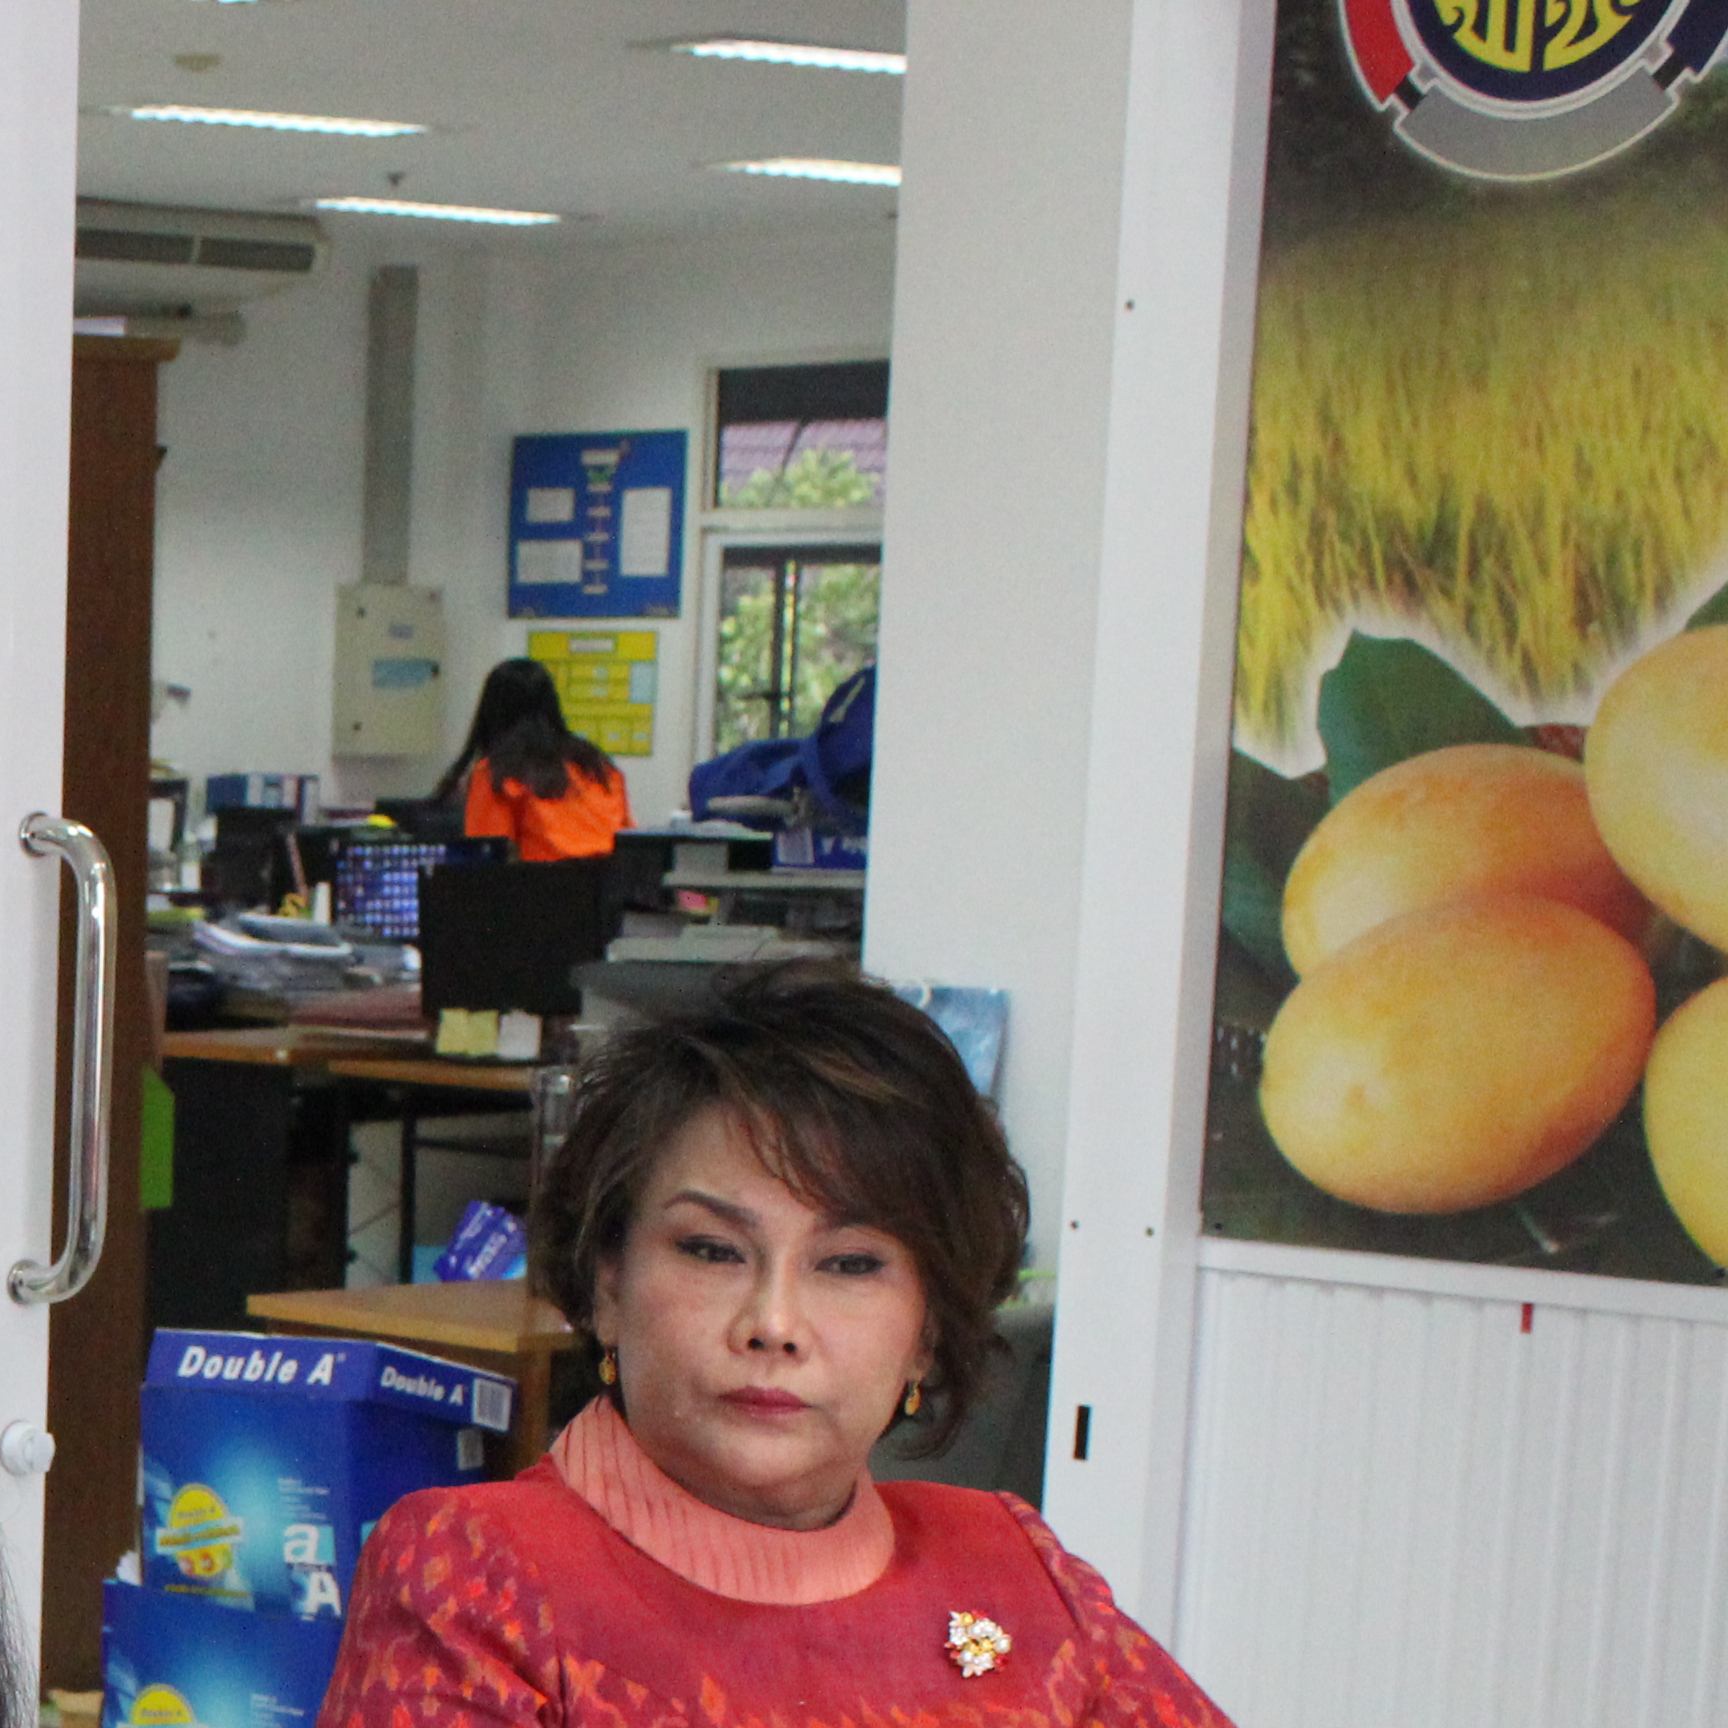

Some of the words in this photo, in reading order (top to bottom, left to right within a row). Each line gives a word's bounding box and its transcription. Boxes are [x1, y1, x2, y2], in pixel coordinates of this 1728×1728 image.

[177, 1345, 301, 1384] Double
[307, 1351, 338, 1386] A
[381, 1366, 446, 1403] Double
[449, 1380, 465, 1406] A
